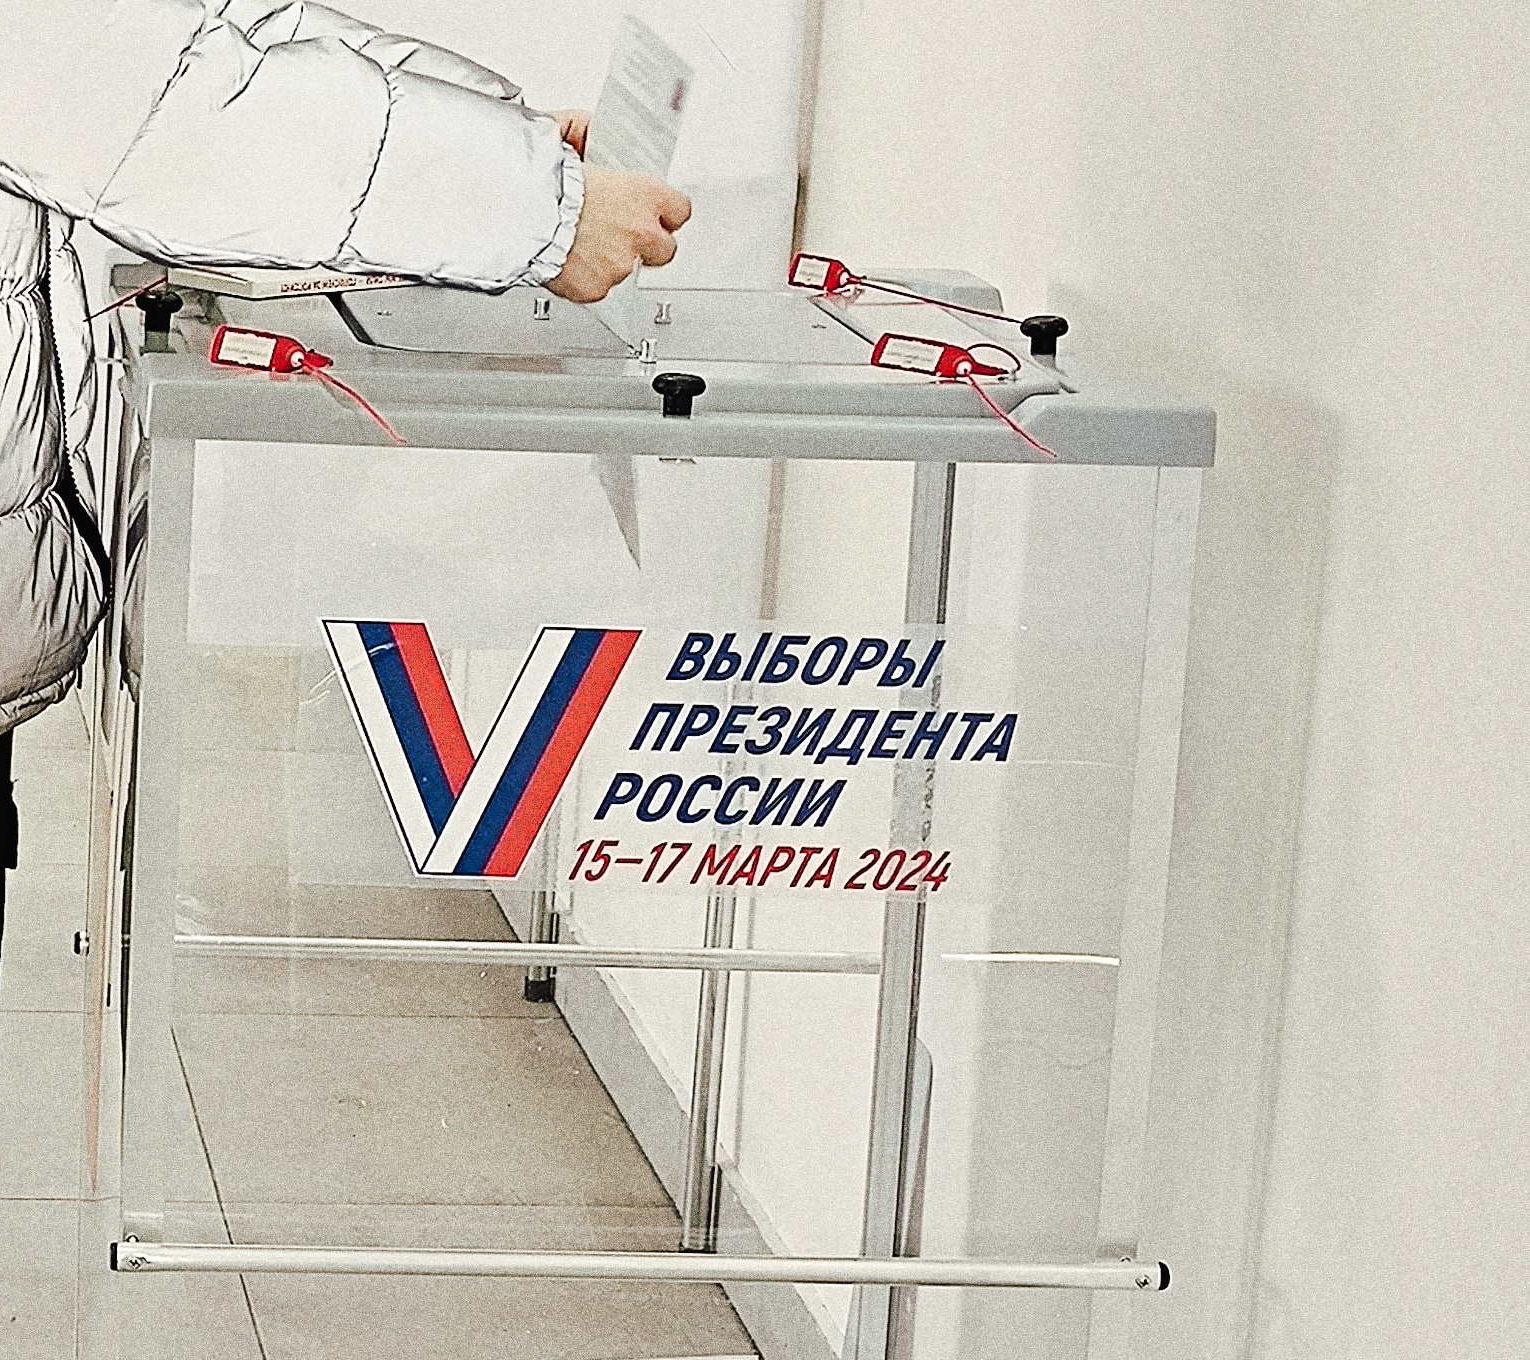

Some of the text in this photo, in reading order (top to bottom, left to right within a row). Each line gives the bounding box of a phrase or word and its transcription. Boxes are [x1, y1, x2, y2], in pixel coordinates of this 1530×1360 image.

[666, 632, 946, 688] ВЫБОРЫ
[629, 703, 1019, 765] ПРЕЗИДЕНТА
[593, 772, 847, 828] РОССИИ
[689, 843, 837, 890] МАРТА
[844, 848, 953, 893] 2024
